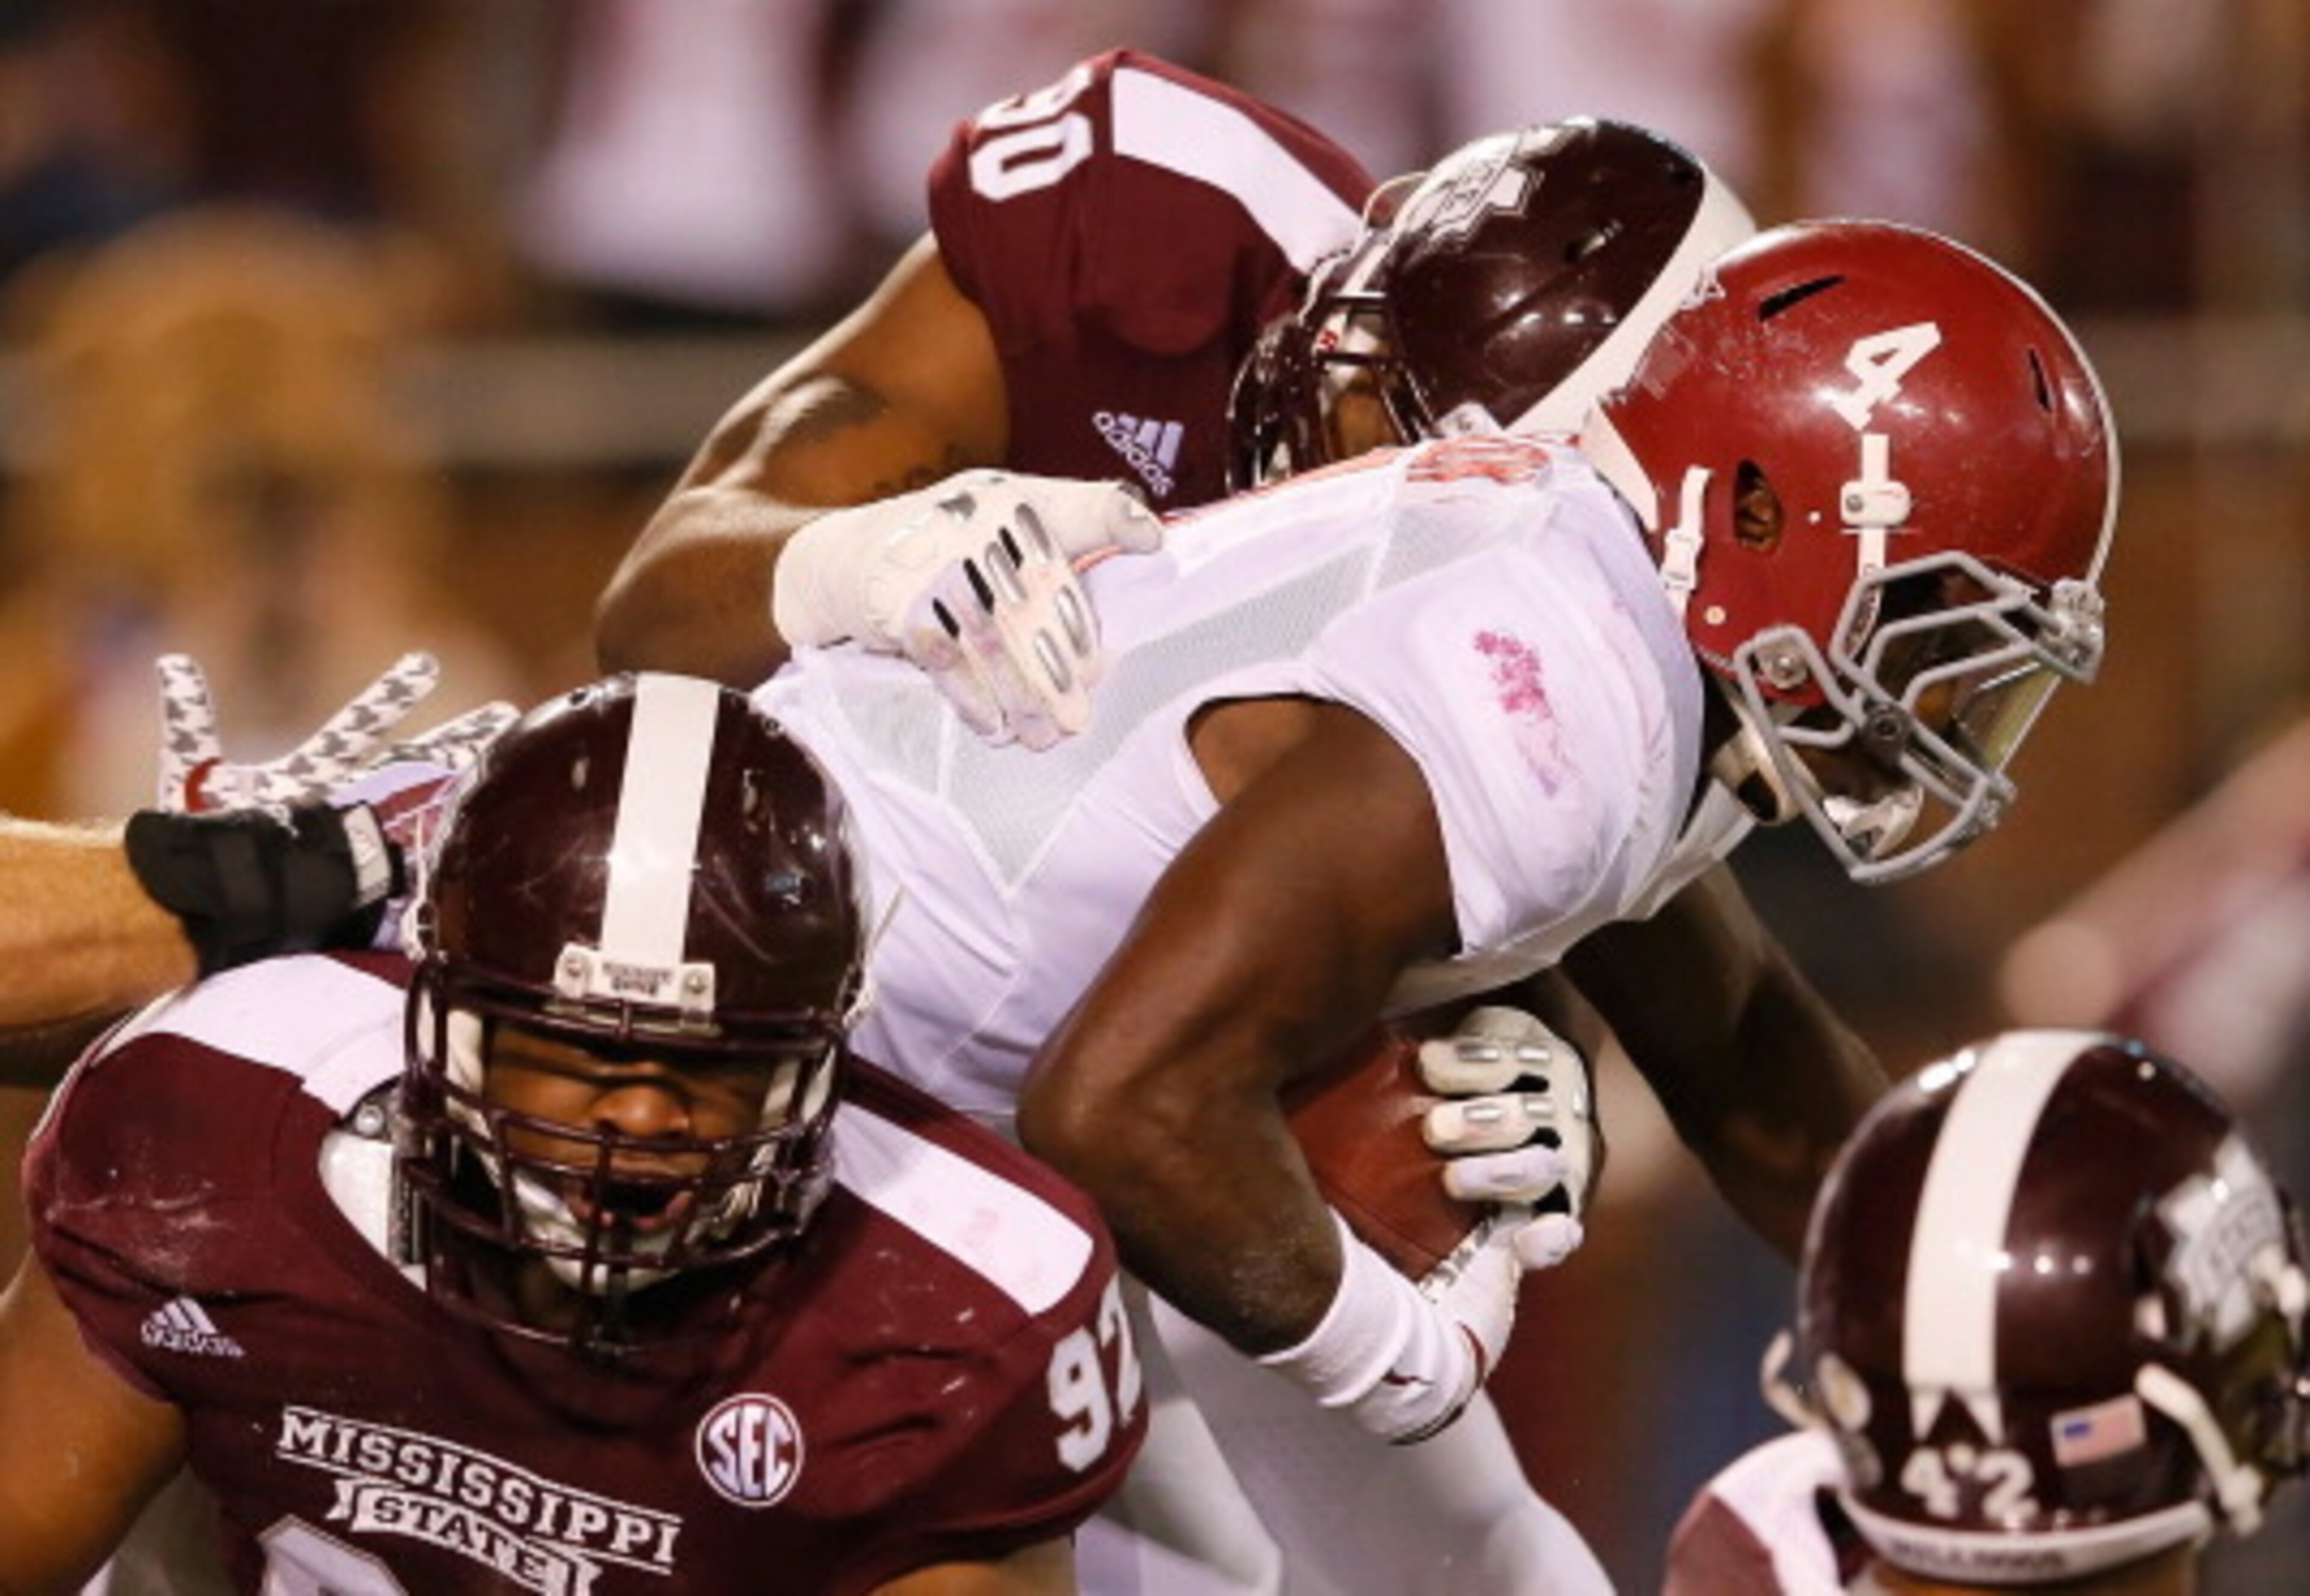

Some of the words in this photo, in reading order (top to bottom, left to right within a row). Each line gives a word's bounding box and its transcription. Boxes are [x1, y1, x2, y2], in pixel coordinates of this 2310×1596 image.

[1832, 321, 1942, 431] 4
[1092, 411, 1175, 497] adidas
[278, 1414, 680, 1564] MISSISSIPPI
[708, 1405, 792, 1498] SEC
[1901, 1447, 2041, 1522] 42
[373, 1496, 548, 1586] STATE
